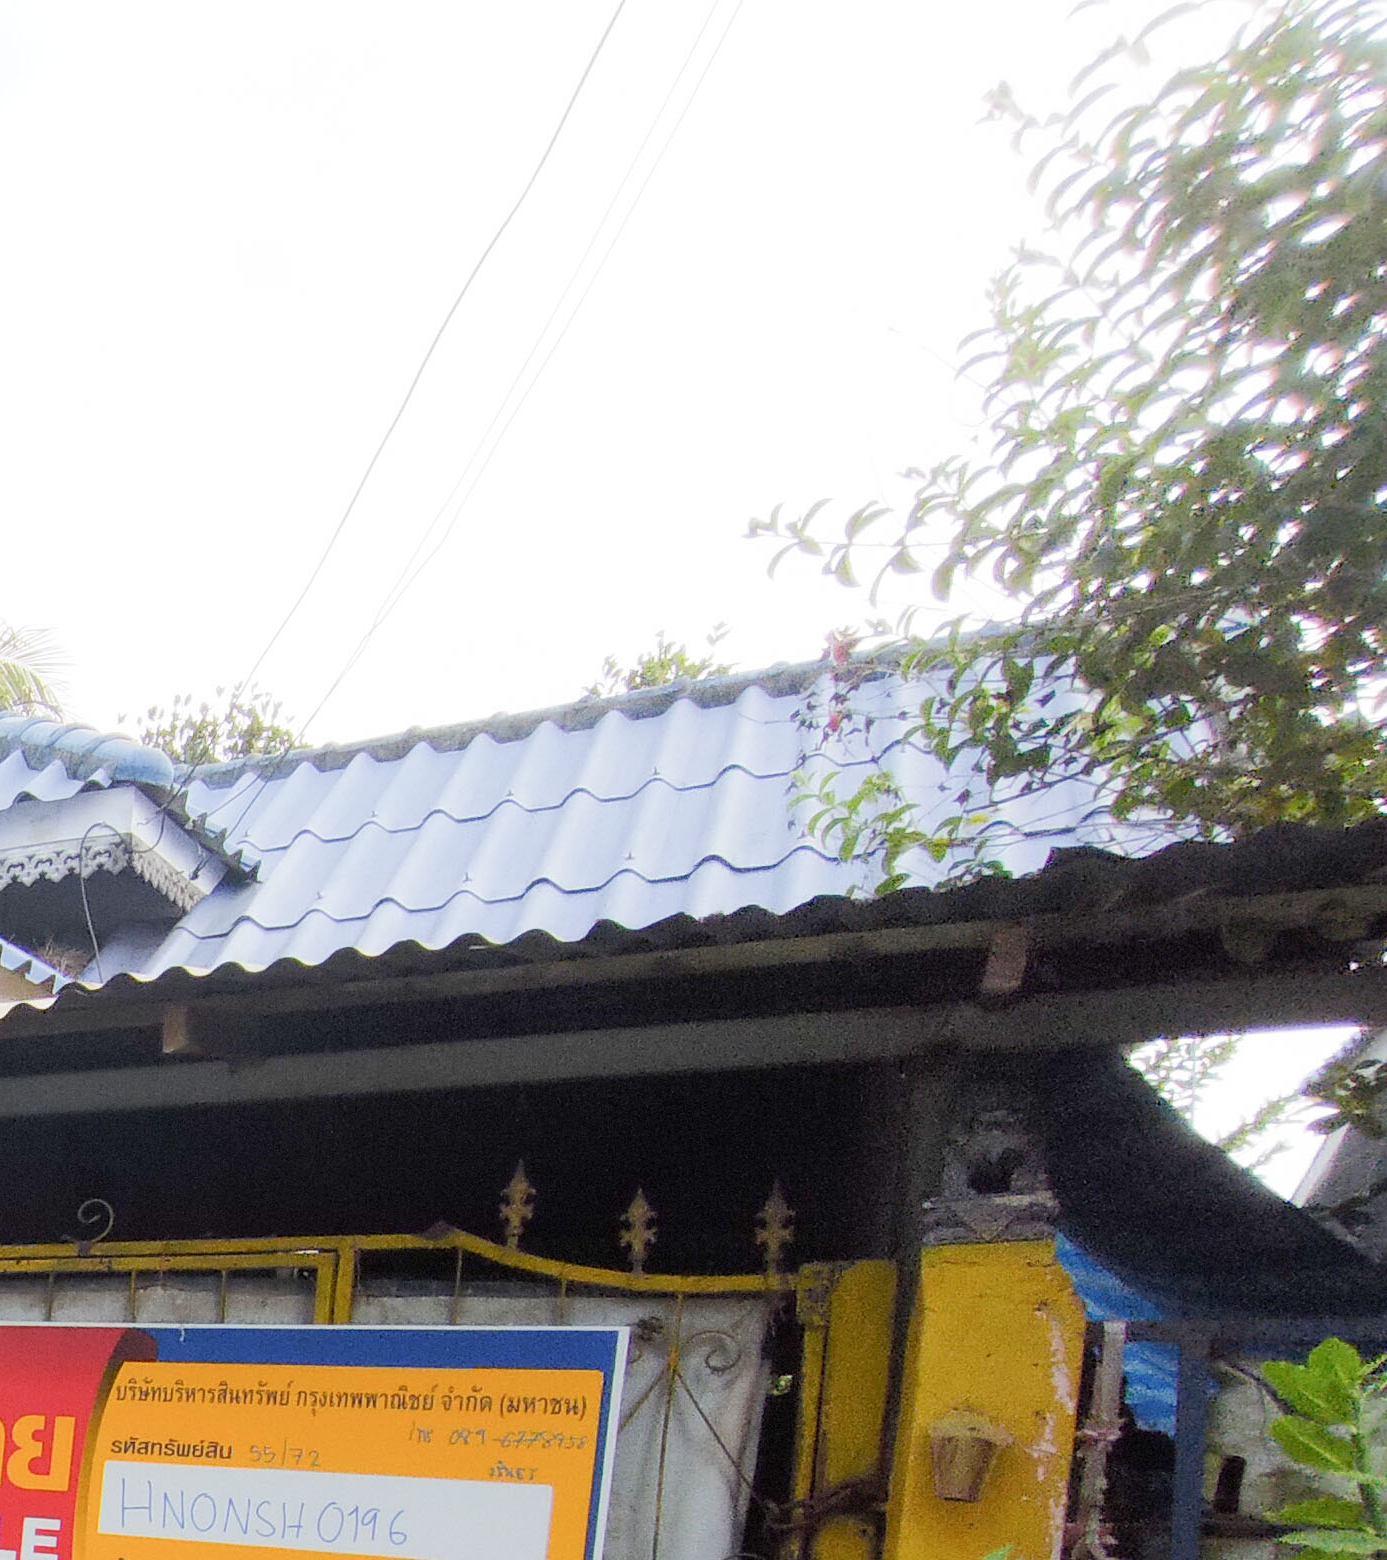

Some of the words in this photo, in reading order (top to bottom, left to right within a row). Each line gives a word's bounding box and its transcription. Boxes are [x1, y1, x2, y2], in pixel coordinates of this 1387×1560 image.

[115, 1377, 294, 1407] บริษัทบริหารสินทรัพย์
[296, 1384, 438, 1416] กรุงเทพพาณิชย์
[441, 1384, 493, 1413] จำกัด
[499, 1393, 587, 1419] (มหาชน)
[110, 1436, 233, 1460] รหัสทรัพย์สิน
